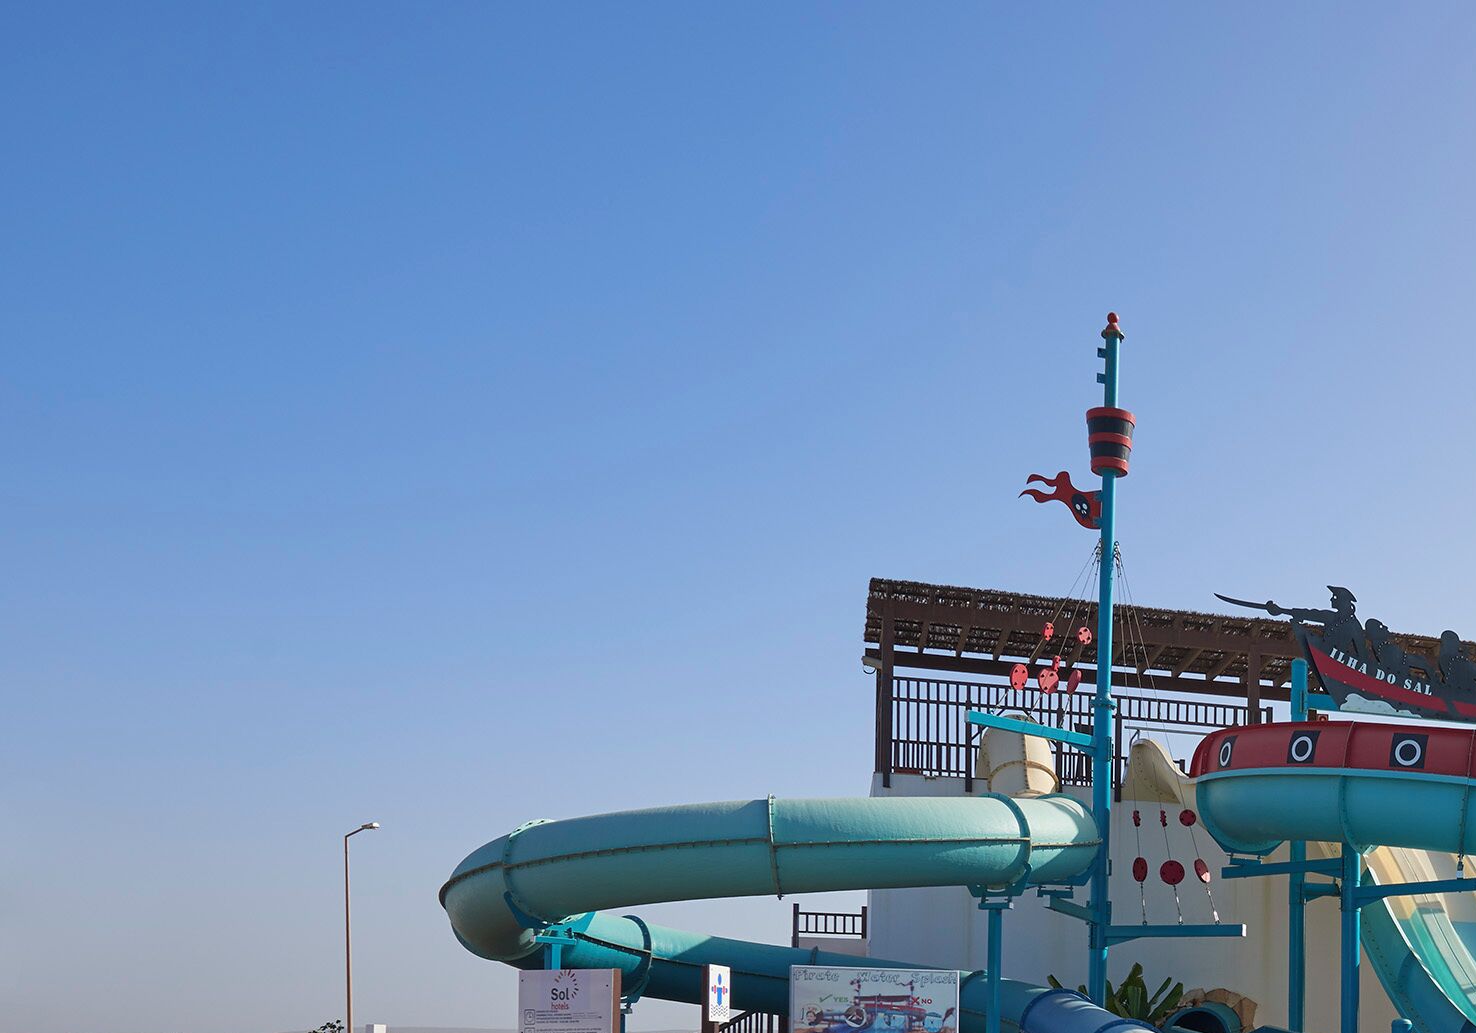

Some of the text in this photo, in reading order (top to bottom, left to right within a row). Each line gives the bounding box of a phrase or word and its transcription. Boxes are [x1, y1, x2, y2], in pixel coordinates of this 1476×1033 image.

[1329, 647, 1433, 696] ILHA DO SAL
[793, 968, 958, 988] Pirate Water Splash
[551, 988, 570, 1001] Sol
[551, 1001, 570, 1010] hotels
